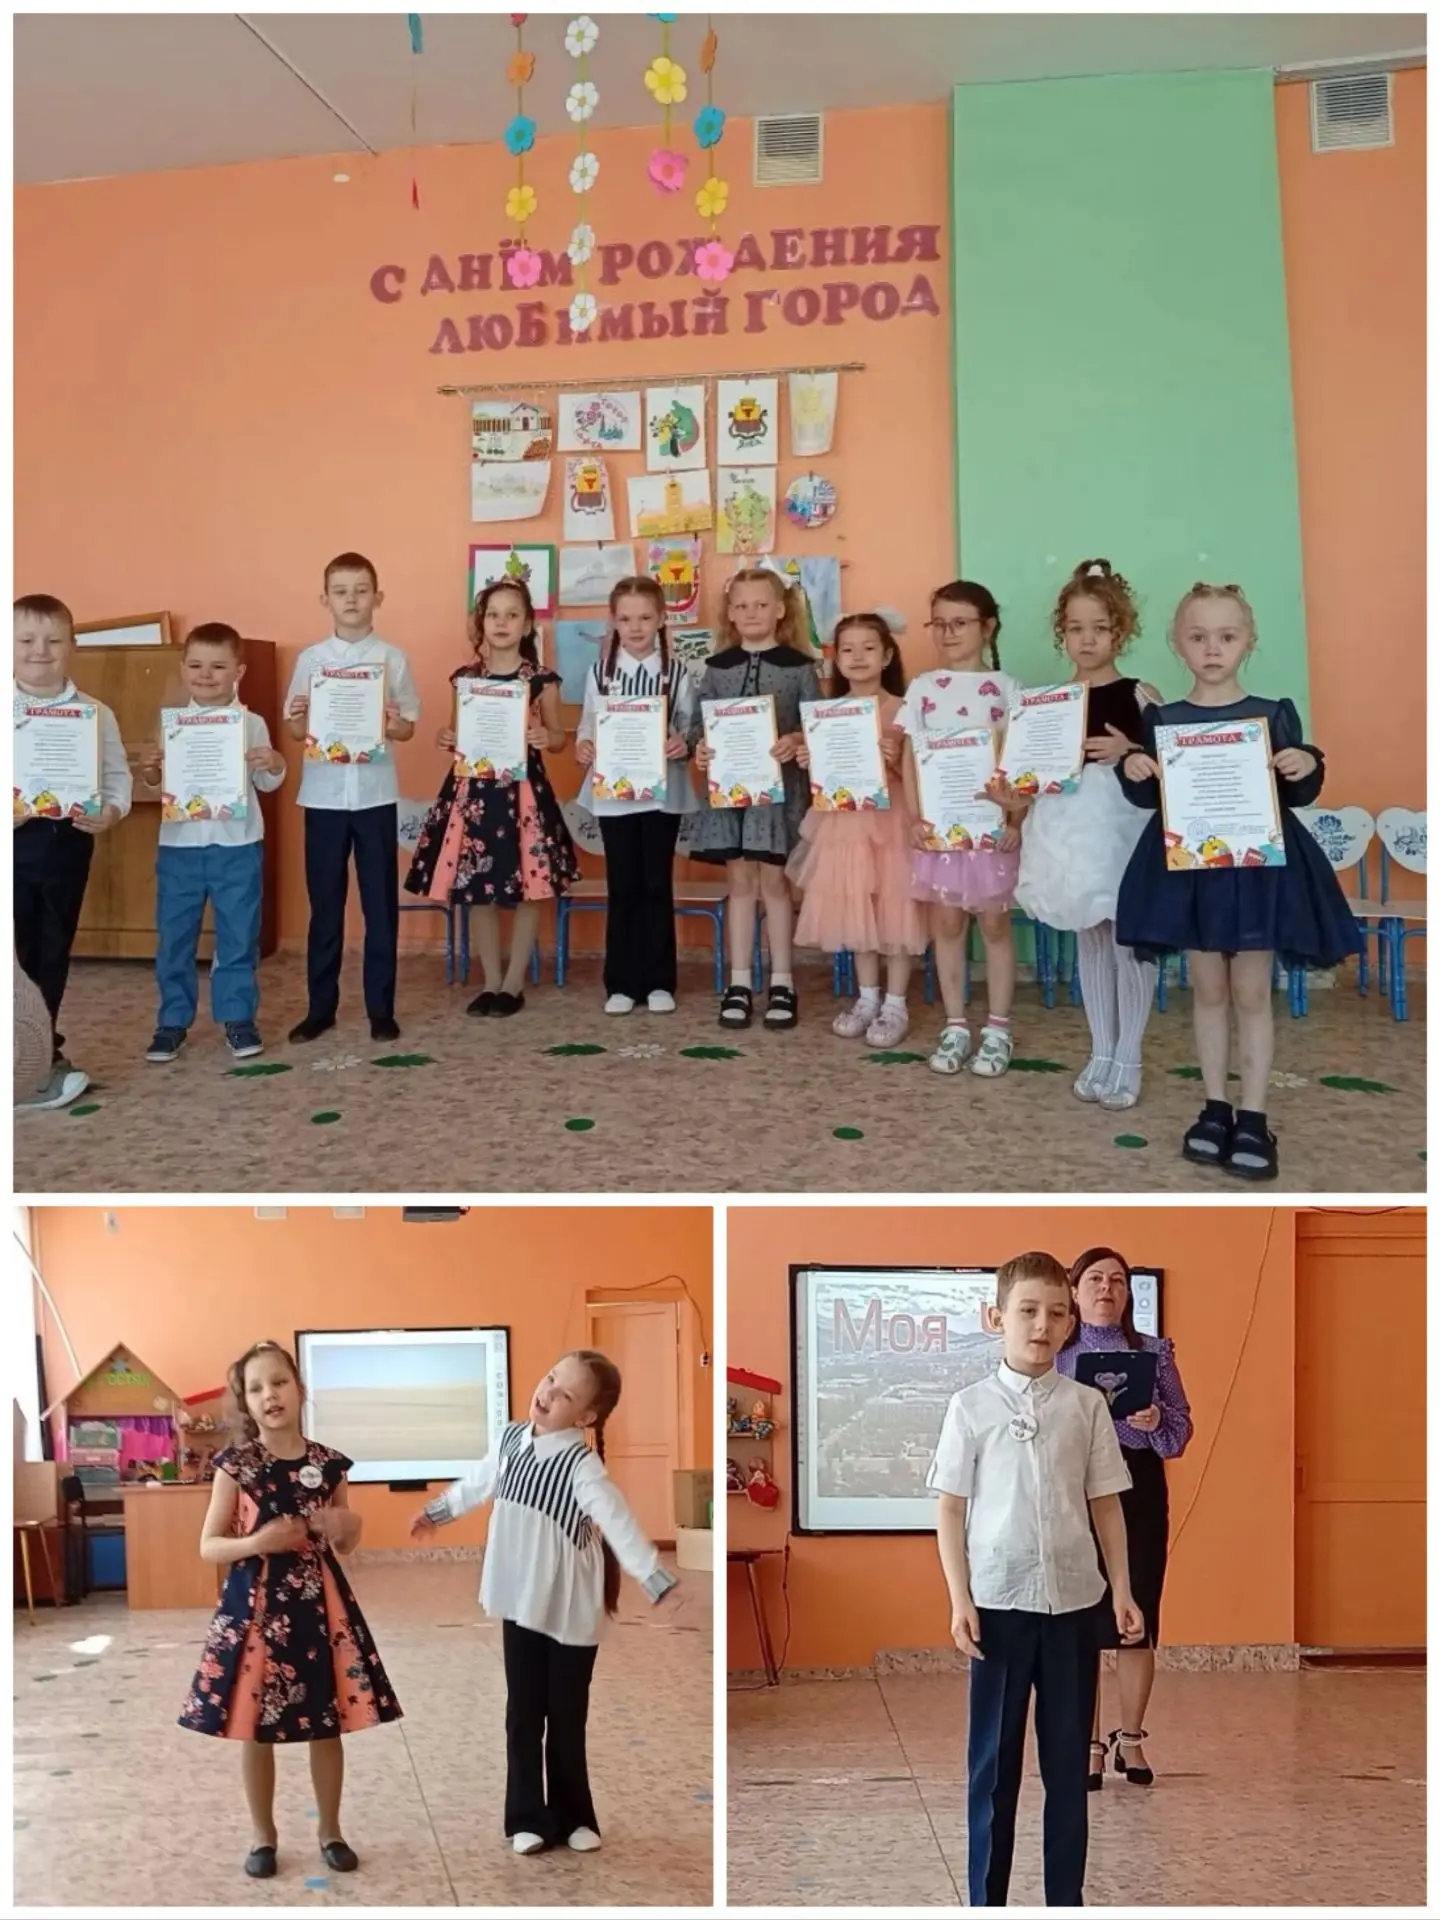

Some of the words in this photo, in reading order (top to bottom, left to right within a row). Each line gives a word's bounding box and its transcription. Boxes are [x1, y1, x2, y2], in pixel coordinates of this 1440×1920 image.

[370, 264, 406, 304] С
[420, 239, 574, 297] ДНЁМ
[744, 274, 940, 333] ГОРОД
[1024, 692, 1066, 706] ГРАМОТА
[1181, 733, 1238, 746] ГРАМОТА
[834, 1296, 948, 1353] Моя
